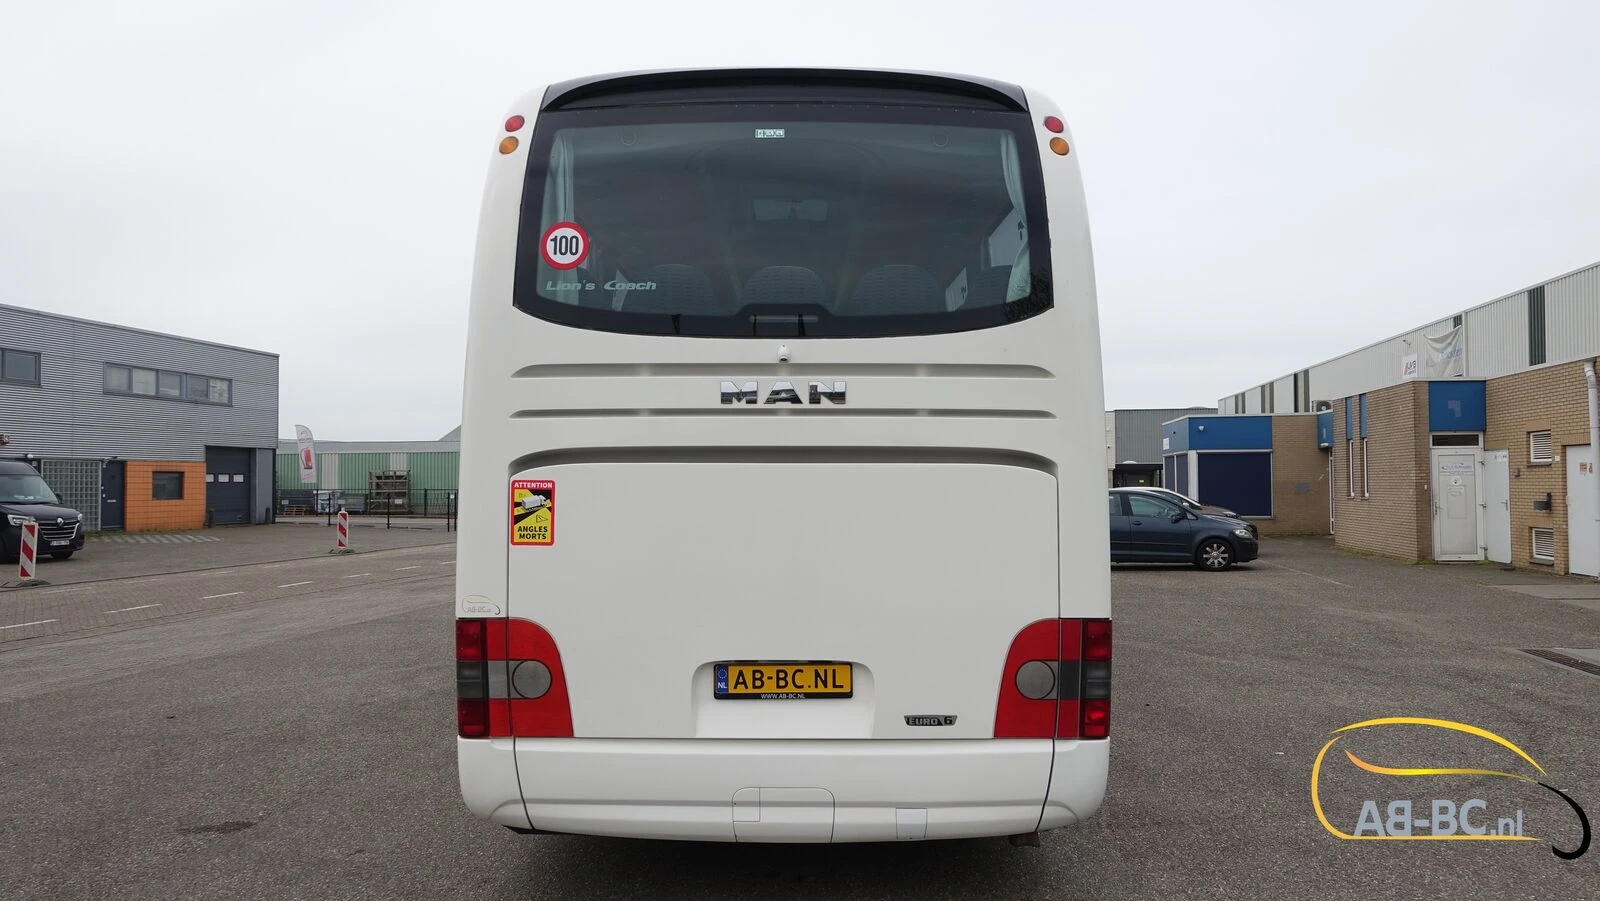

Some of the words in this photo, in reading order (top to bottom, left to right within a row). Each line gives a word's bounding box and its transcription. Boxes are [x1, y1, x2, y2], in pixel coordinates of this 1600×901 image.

[550, 235, 579, 256] 100
[545, 280, 596, 291] Lion's
[603, 280, 657, 291] Coach
[720, 381, 846, 404] MAN
[517, 525, 548, 533] ANGLES
[733, 668, 844, 690] AB-BC.NL
[909, 717, 939, 726] EURO
[944, 716, 953, 725] 6
